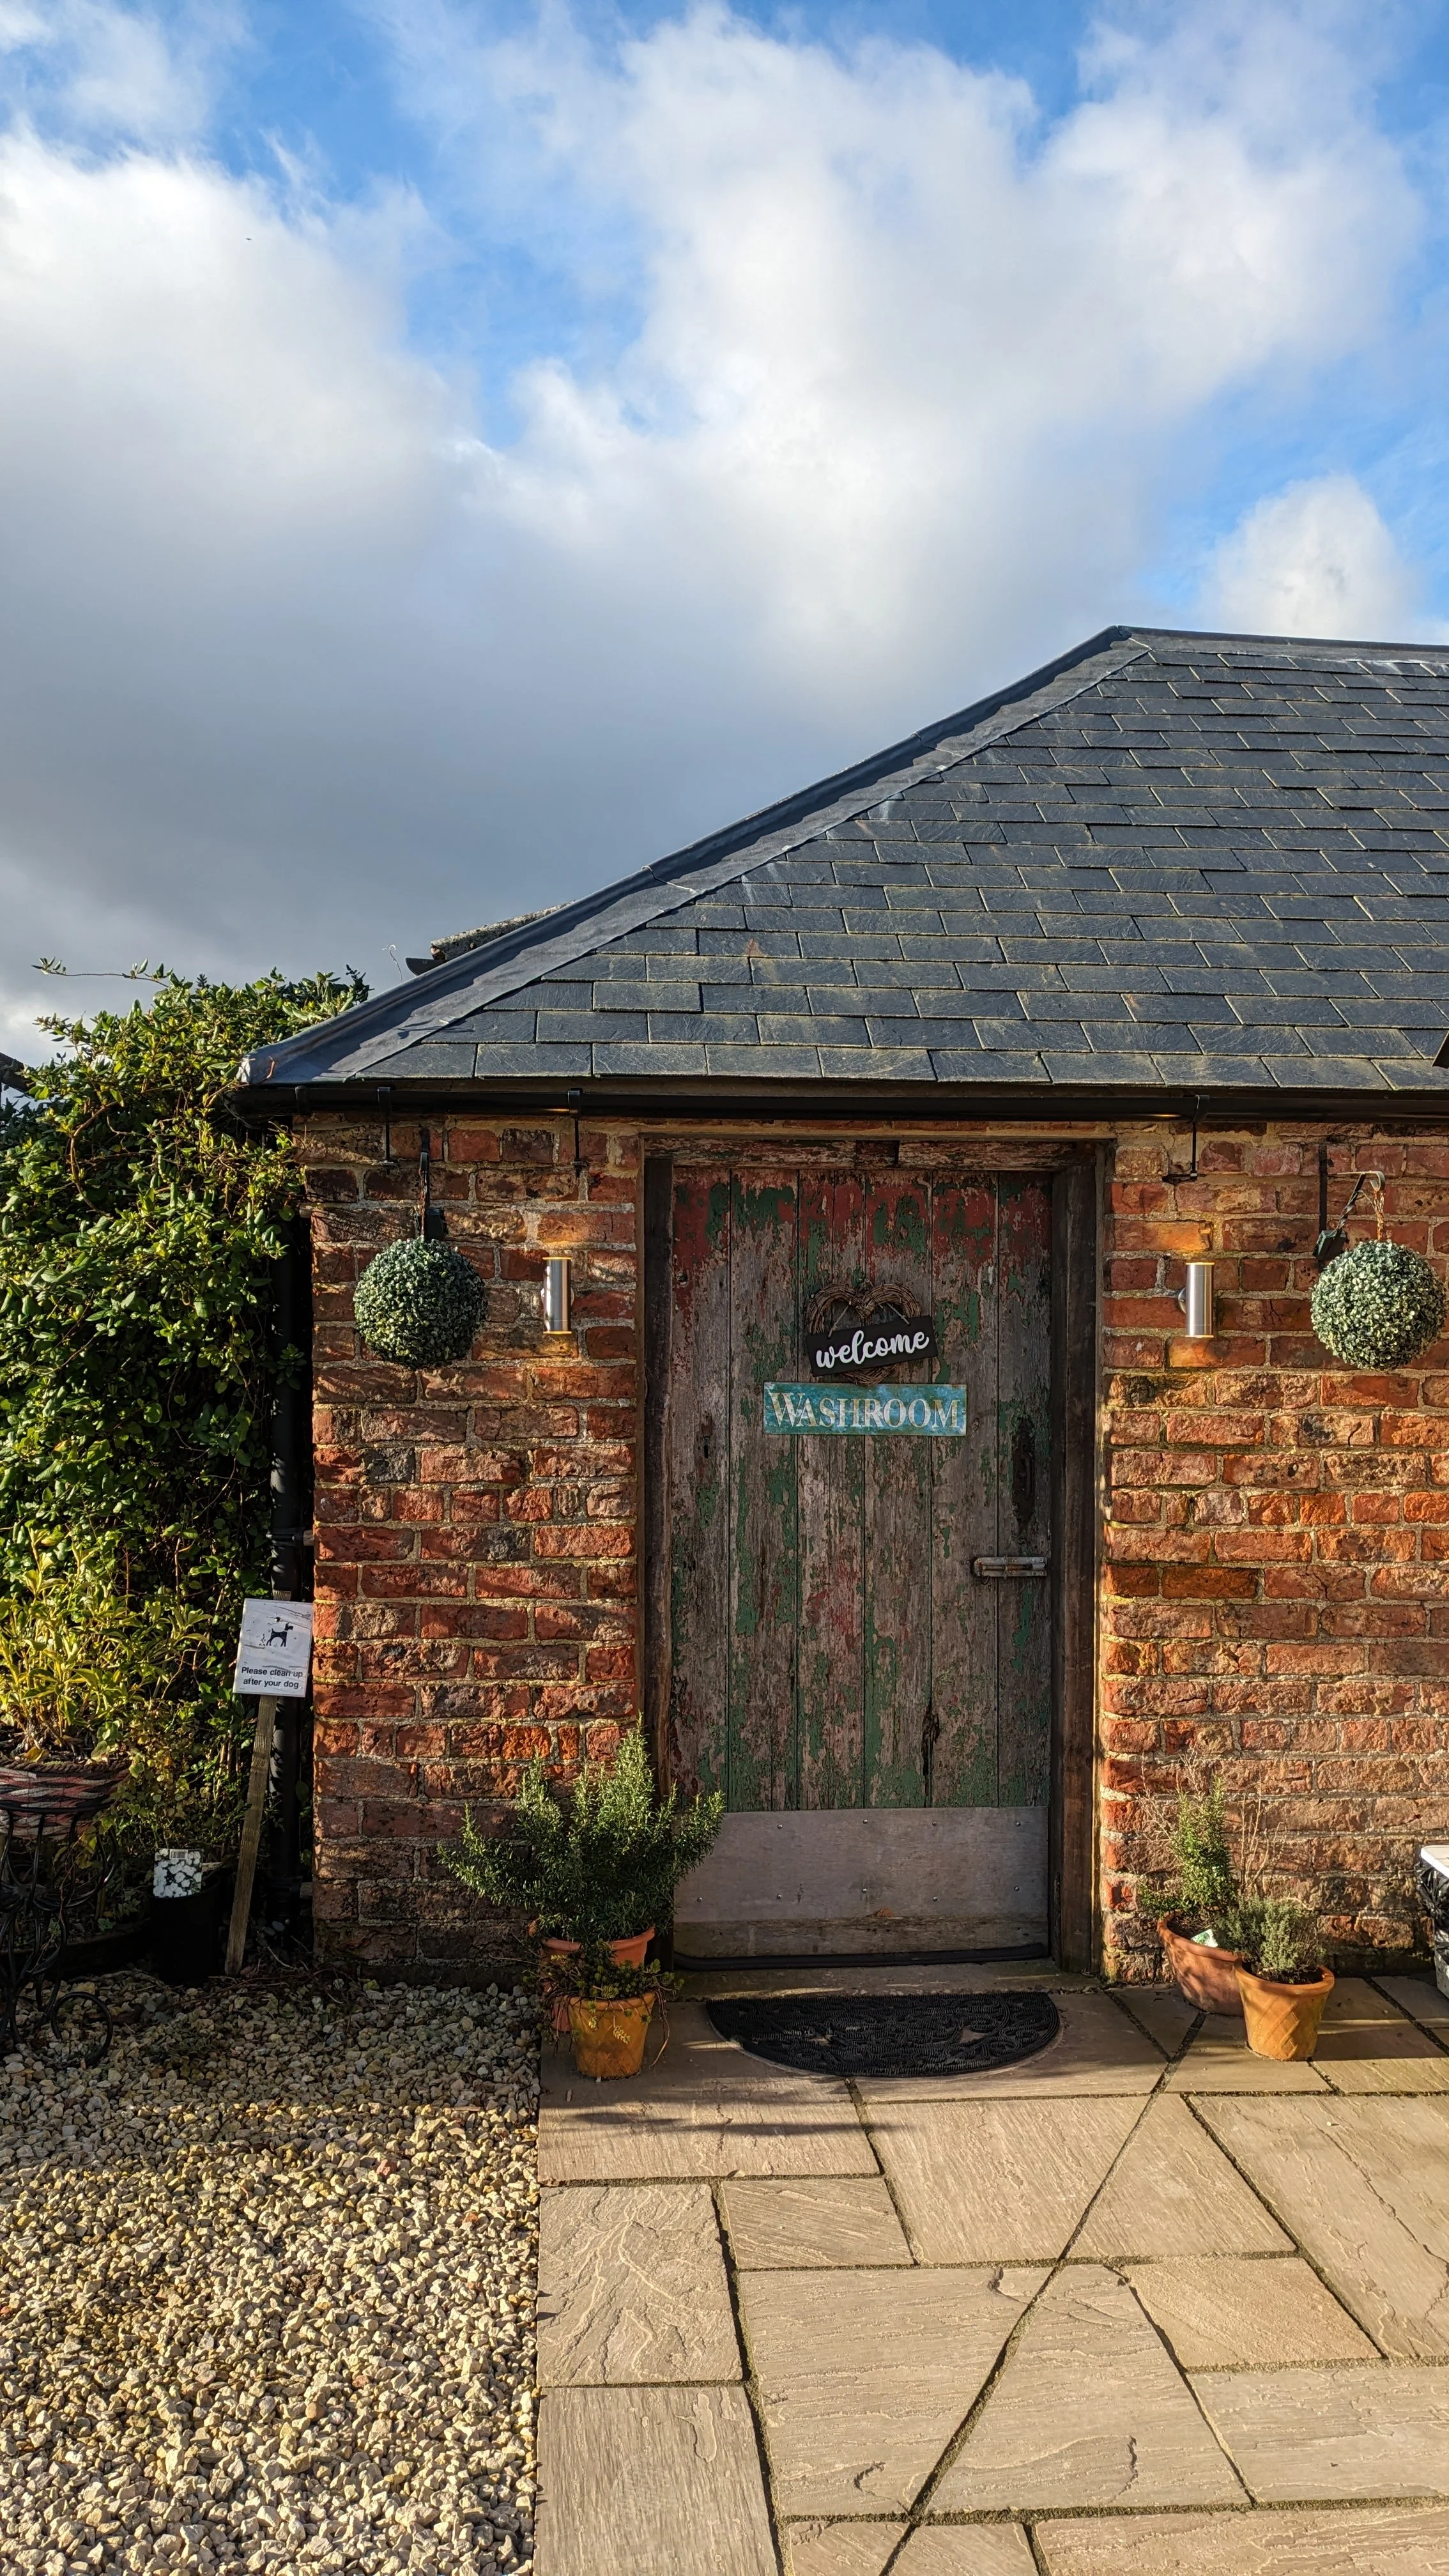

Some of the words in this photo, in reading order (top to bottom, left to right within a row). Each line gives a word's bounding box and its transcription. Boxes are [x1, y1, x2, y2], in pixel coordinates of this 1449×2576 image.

[815, 1330, 930, 1369] welcome
[767, 1392, 961, 1429] WASHROOM
[284, 1680, 299, 1689] dog
